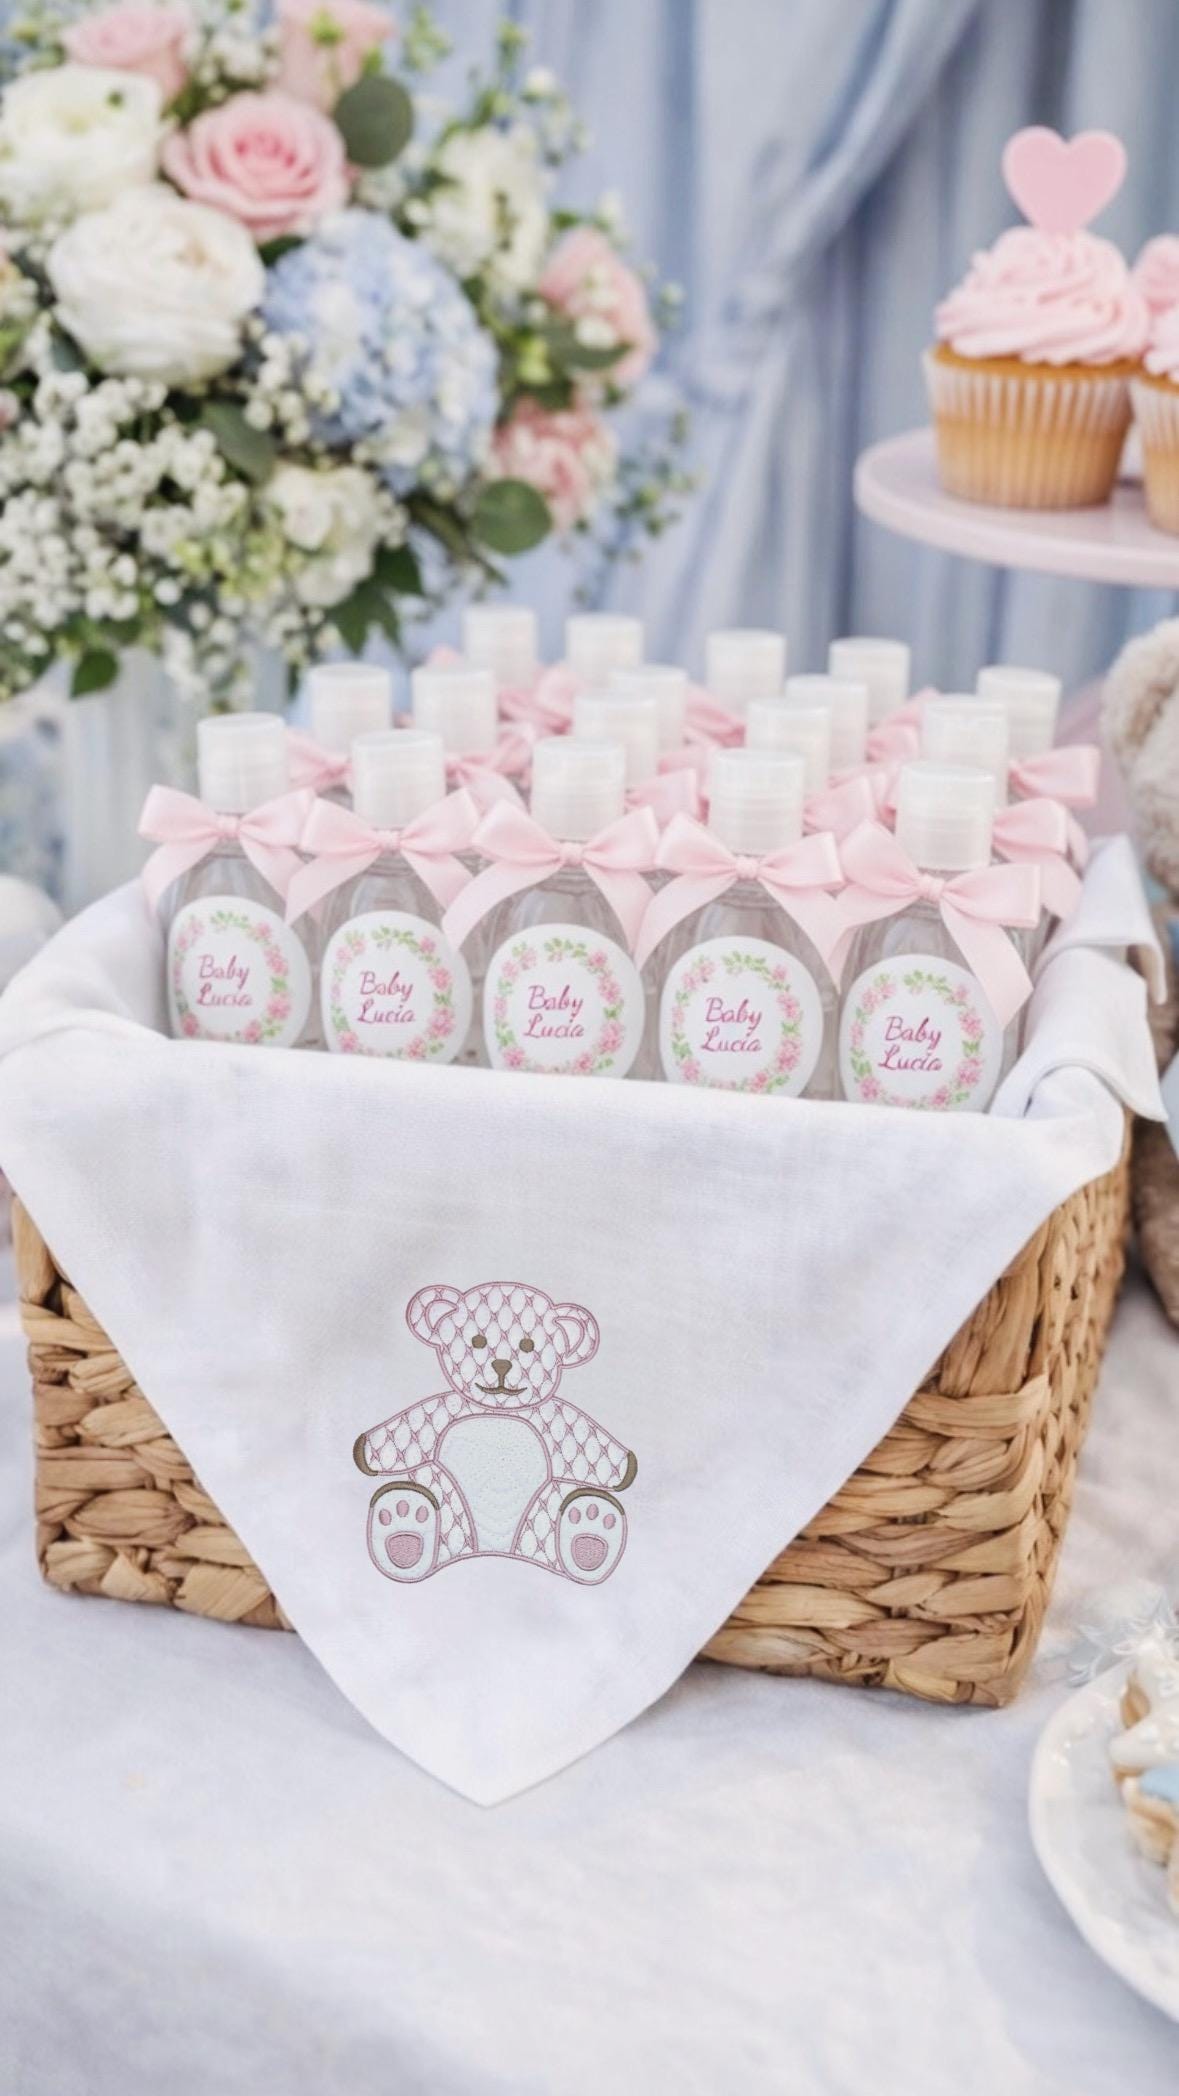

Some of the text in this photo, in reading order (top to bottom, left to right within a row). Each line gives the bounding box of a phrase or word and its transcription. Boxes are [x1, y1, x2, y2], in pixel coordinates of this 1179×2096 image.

[199, 954, 249, 990] Baby
[360, 971, 413, 1002] Baby
[528, 985, 583, 1017] Baby
[705, 997, 762, 1030] Baby
[884, 1016, 941, 1050] Baby
